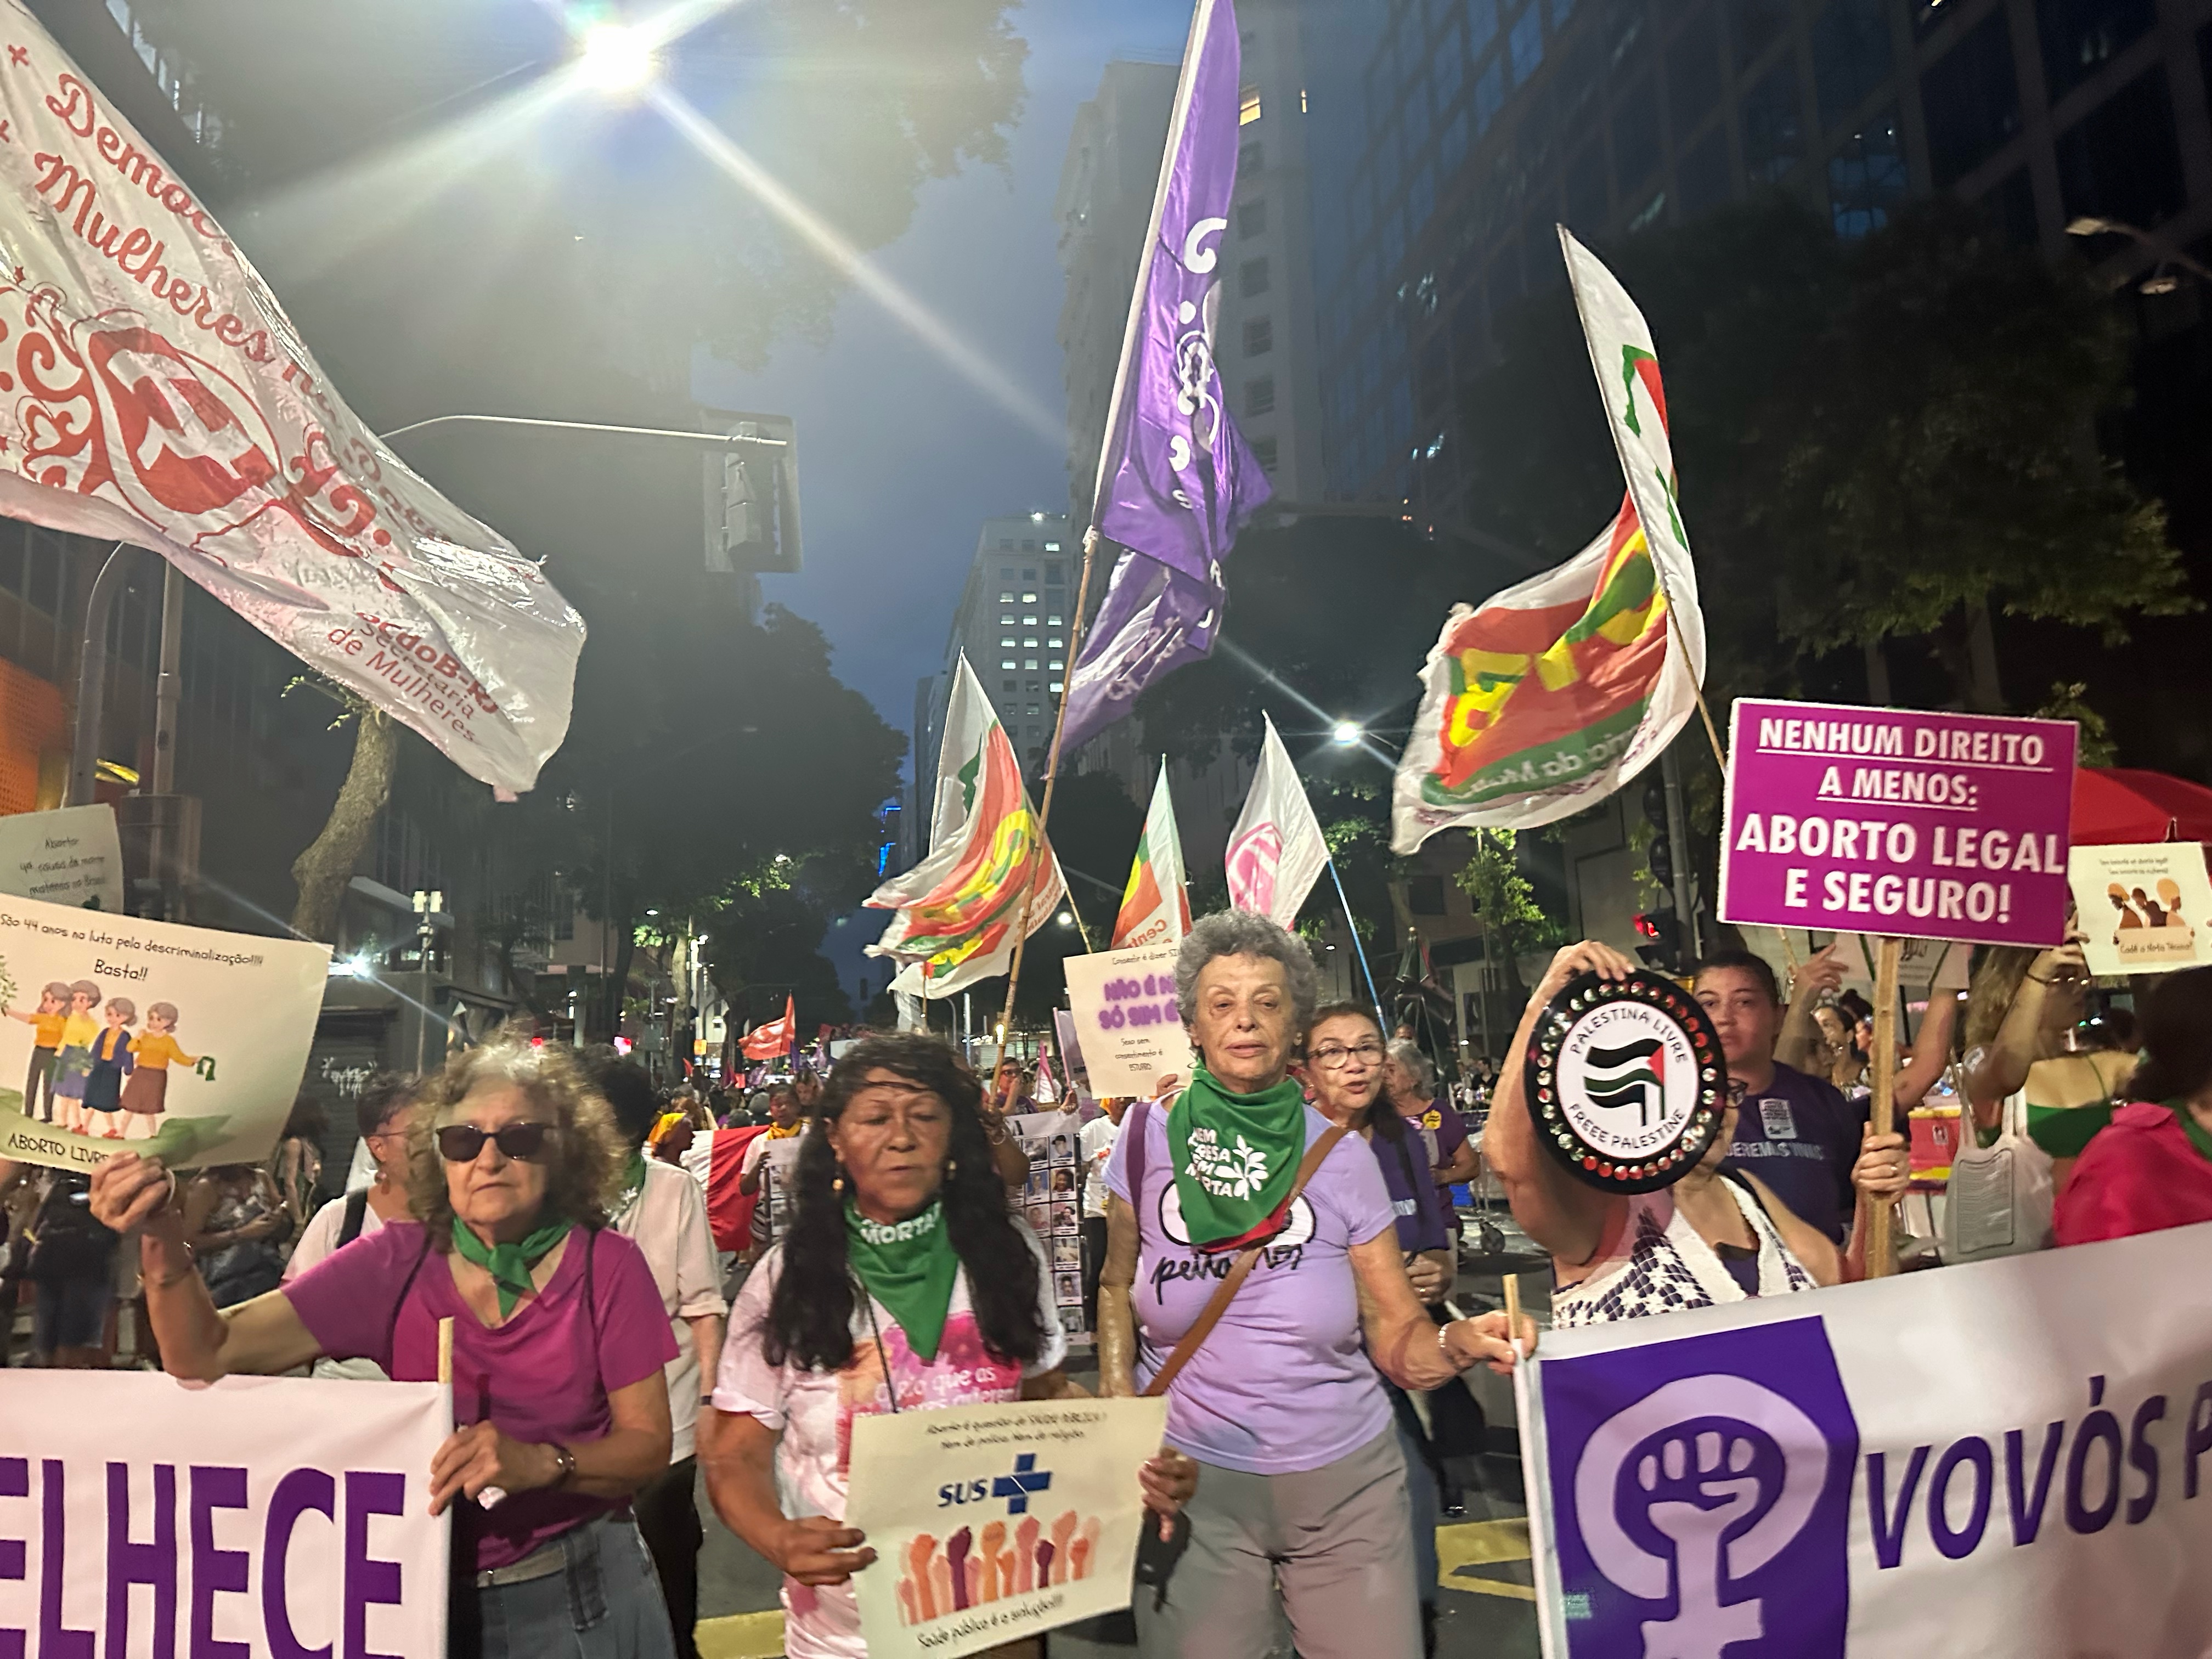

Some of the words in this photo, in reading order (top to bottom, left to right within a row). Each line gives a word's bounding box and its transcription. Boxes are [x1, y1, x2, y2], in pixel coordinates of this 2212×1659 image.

[46, 74, 238, 262] Democ
[34, 152, 275, 363] Mulheres
[328, 629, 363, 656] de
[366, 651, 476, 741] Mulheres
[1758, 718, 1904, 756] NENHUM
[1914, 728, 2044, 765] DIREITO
[1818, 766, 1843, 796] A
[1852, 768, 1978, 805] MENOS:
[1735, 813, 1917, 864] ABORTO
[1932, 826, 2066, 875] LEGAL
[1785, 868, 1809, 908] E
[1822, 870, 2012, 924] SEGURO!
[1, 913, 20, 927] São
[24, 918, 38, 930] 44
[42, 926, 69, 937] anos
[89, 929, 113, 945] luta
[94, 958, 148, 981] Basta!!
[1104, 978, 1141, 1001] NÃO
[1143, 972, 1156, 996] É
[1098, 1005, 1125, 1030] SÓ
[1127, 1004, 1162, 1026] SIM
[1570, 1007, 1651, 1054] PALESTINA
[1652, 1018, 1689, 1064] LIVRE
[8, 1133, 65, 1156] ABORTO
[1611, 1108, 1688, 1149] PALESTINE
[1185, 1163, 1233, 1198] MRTA
[937, 1478, 989, 1508] SUS
[1867, 1375, 2166, 1570] VOVÓS
